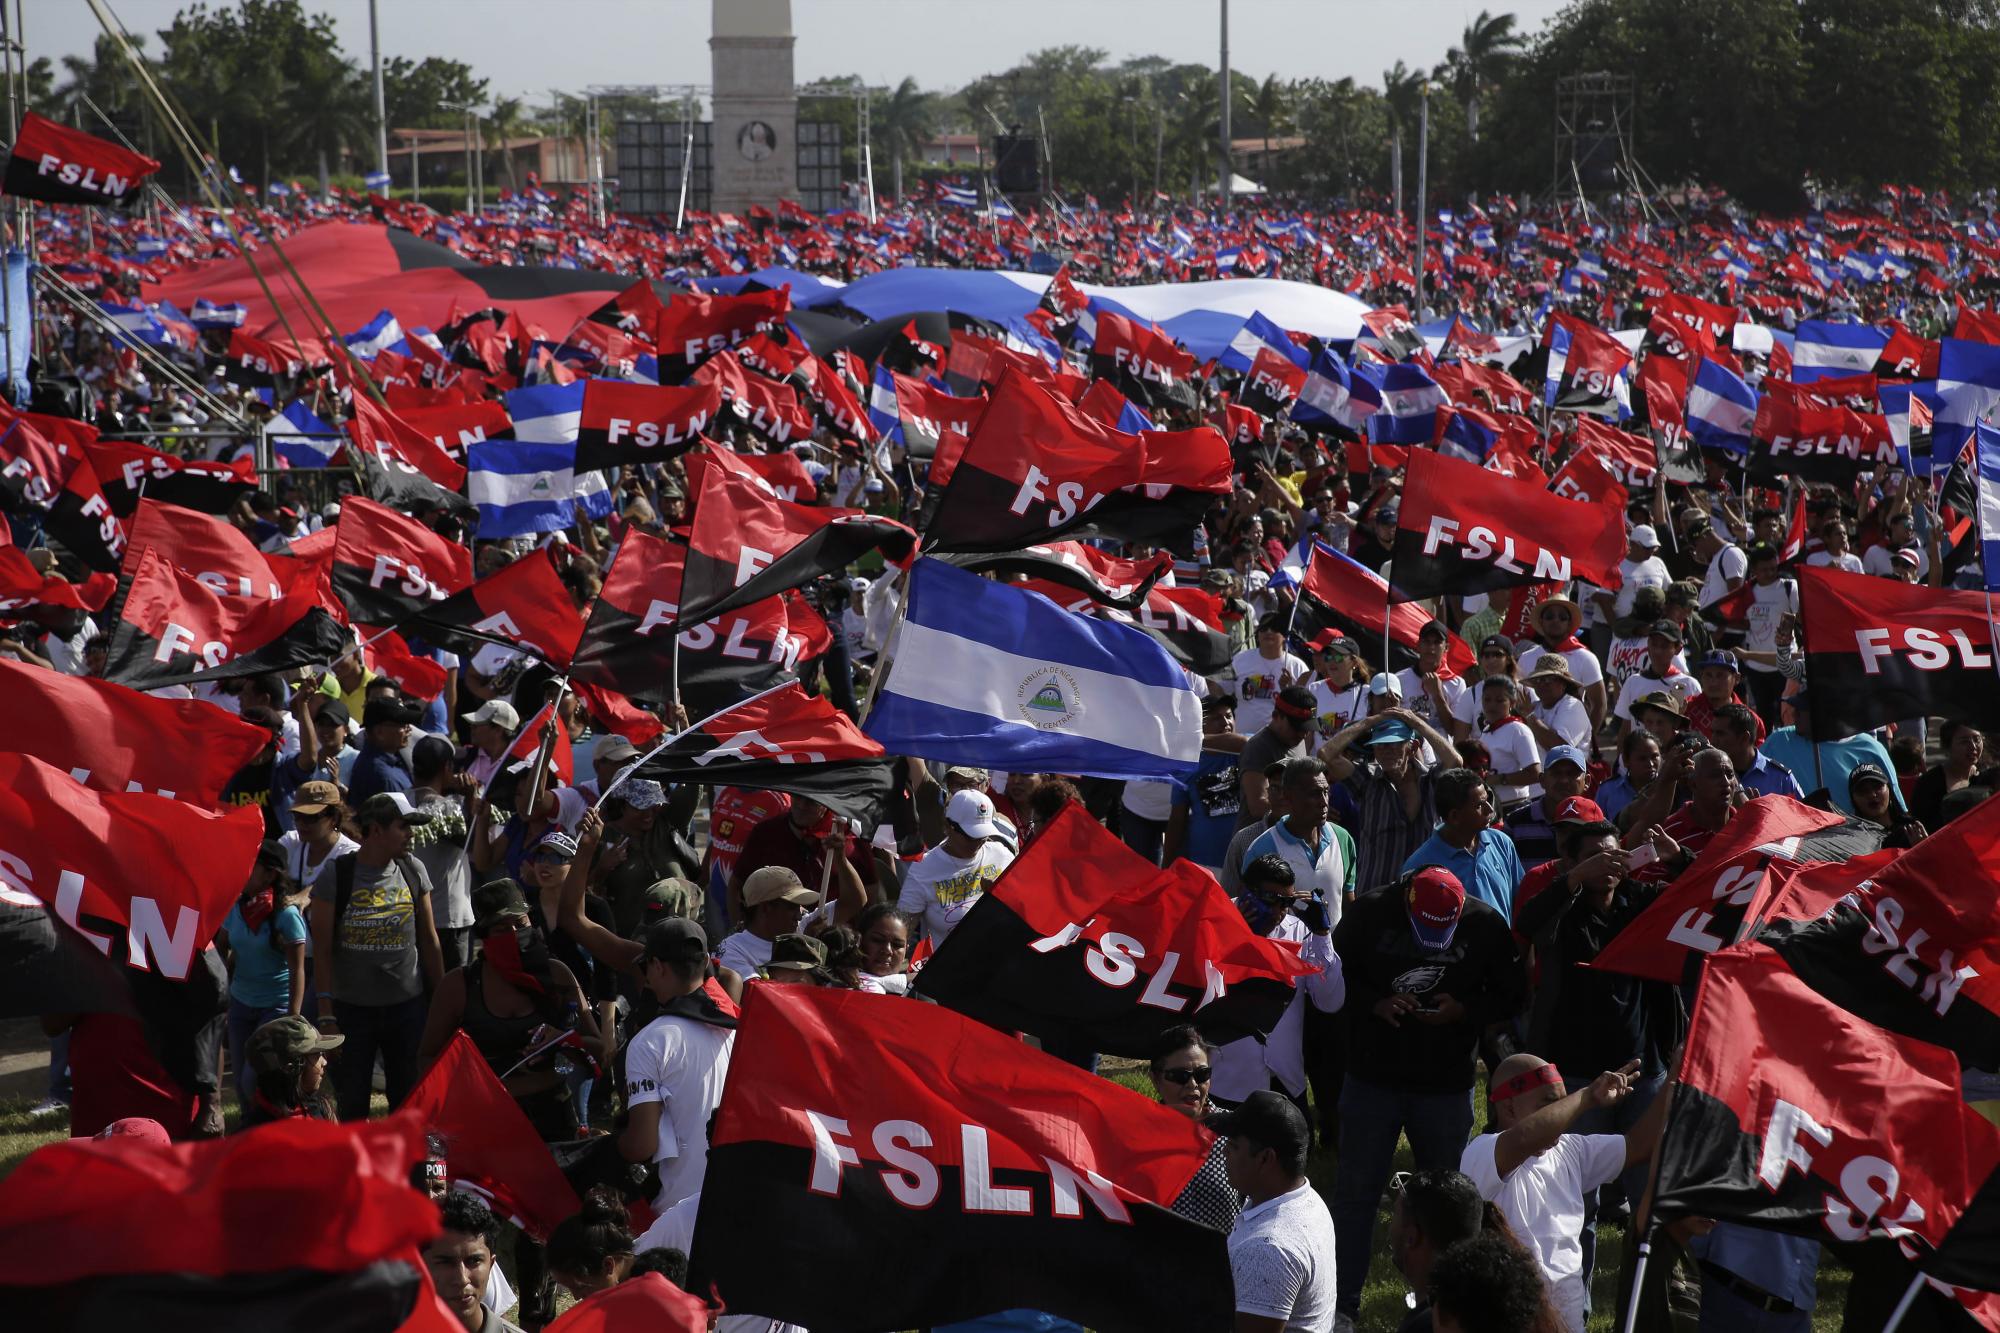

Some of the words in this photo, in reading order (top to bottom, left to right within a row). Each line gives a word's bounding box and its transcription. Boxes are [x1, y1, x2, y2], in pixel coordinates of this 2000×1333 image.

[38, 153, 128, 198] FSLN
[1571, 366, 1615, 398] FSL
[607, 406, 708, 447] FSLN
[1770, 434, 1862, 463] FSLN
[1423, 514, 1572, 582] FSLN
[1855, 627, 2000, 674] FSL
[1050, 666, 1060, 674] DE
[1059, 670, 1080, 706] NICARAGUA
[1043, 711, 1075, 729] CENTRAL
[0, 850, 200, 980] SLN
[806, 1108, 1133, 1226] FSLN
